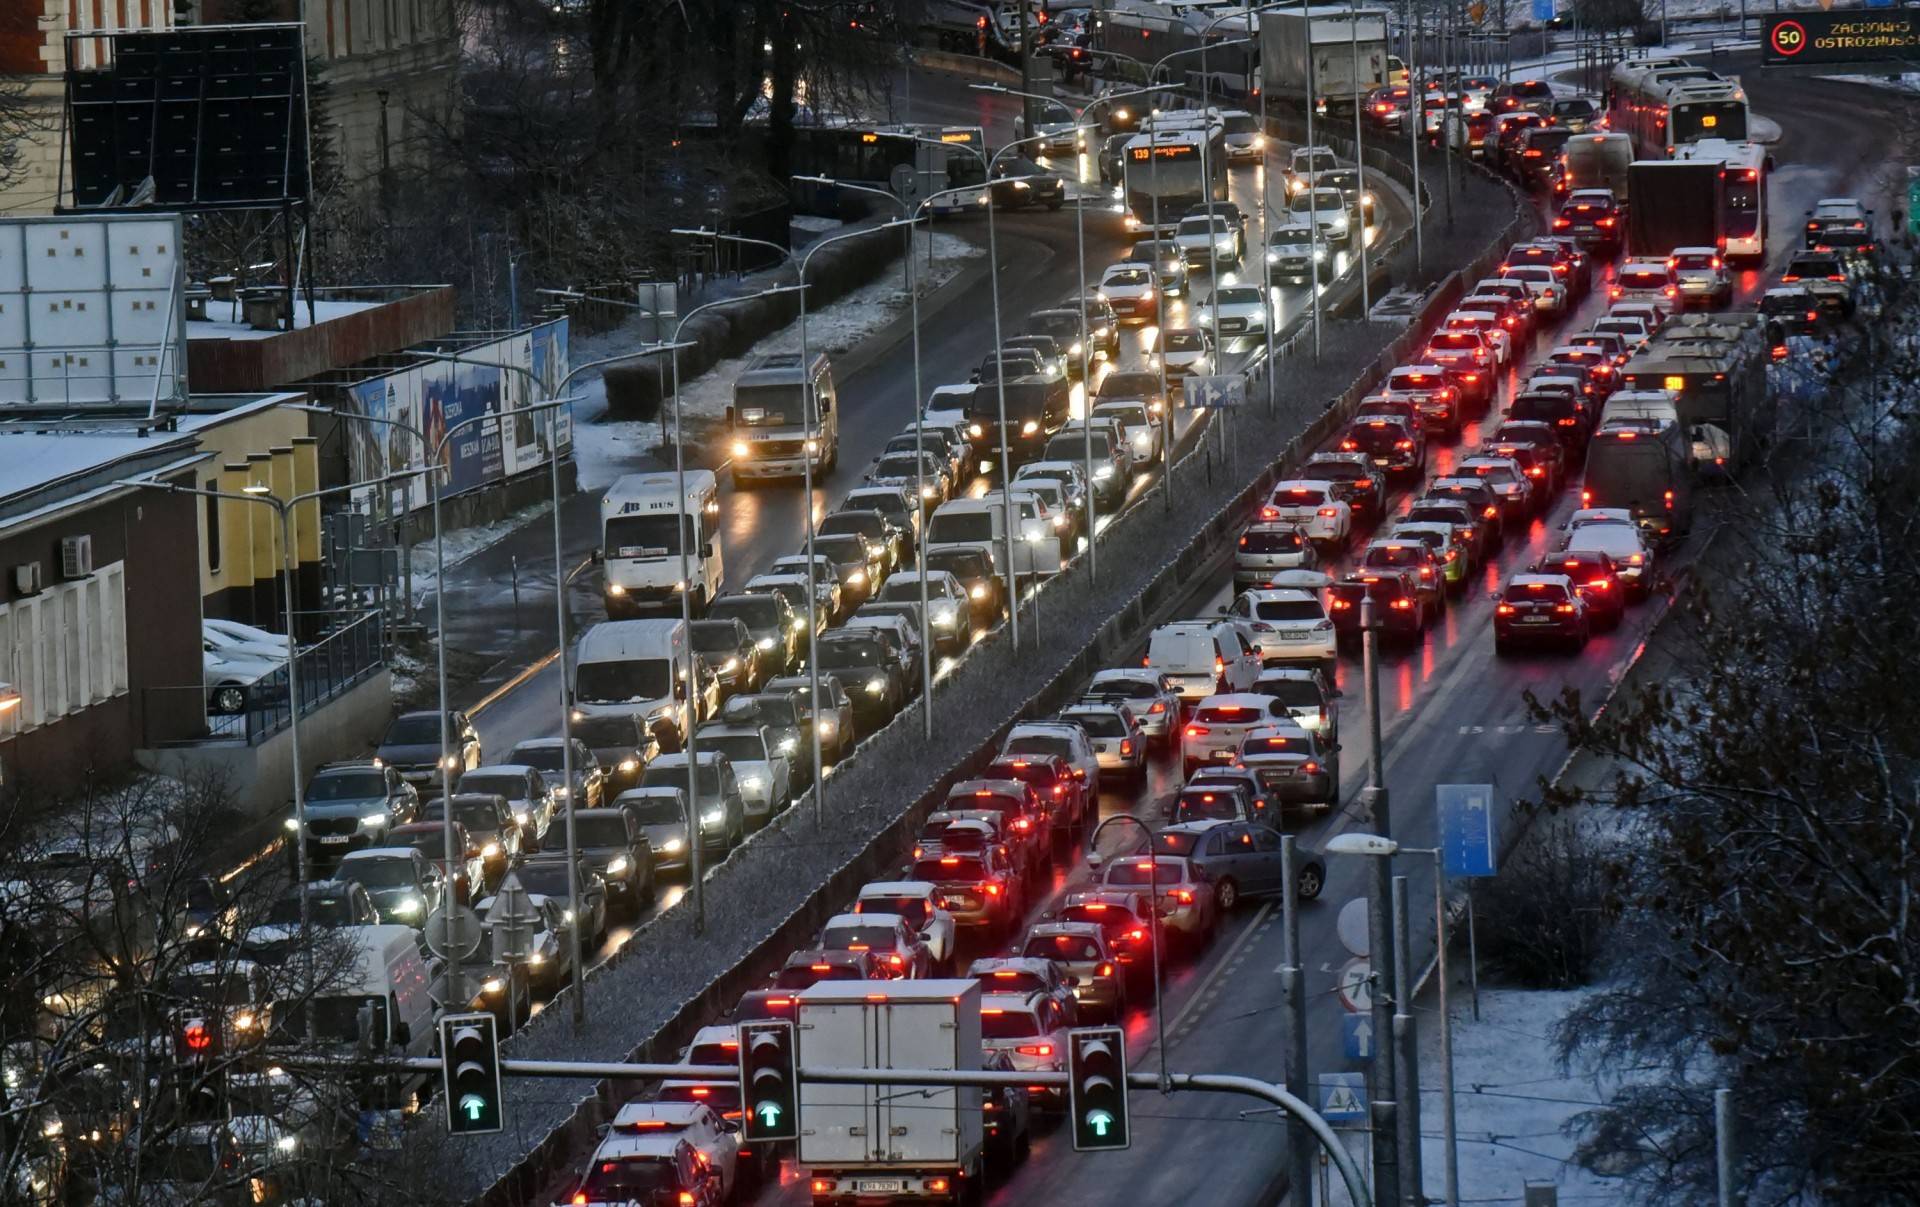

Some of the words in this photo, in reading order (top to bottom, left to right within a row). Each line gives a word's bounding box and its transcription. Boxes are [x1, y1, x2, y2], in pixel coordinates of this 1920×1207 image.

[1778, 31, 1800, 44] 50
[1134, 149, 1149, 159] 139
[616, 501, 640, 515] AB
[650, 501, 674, 509] BUS
